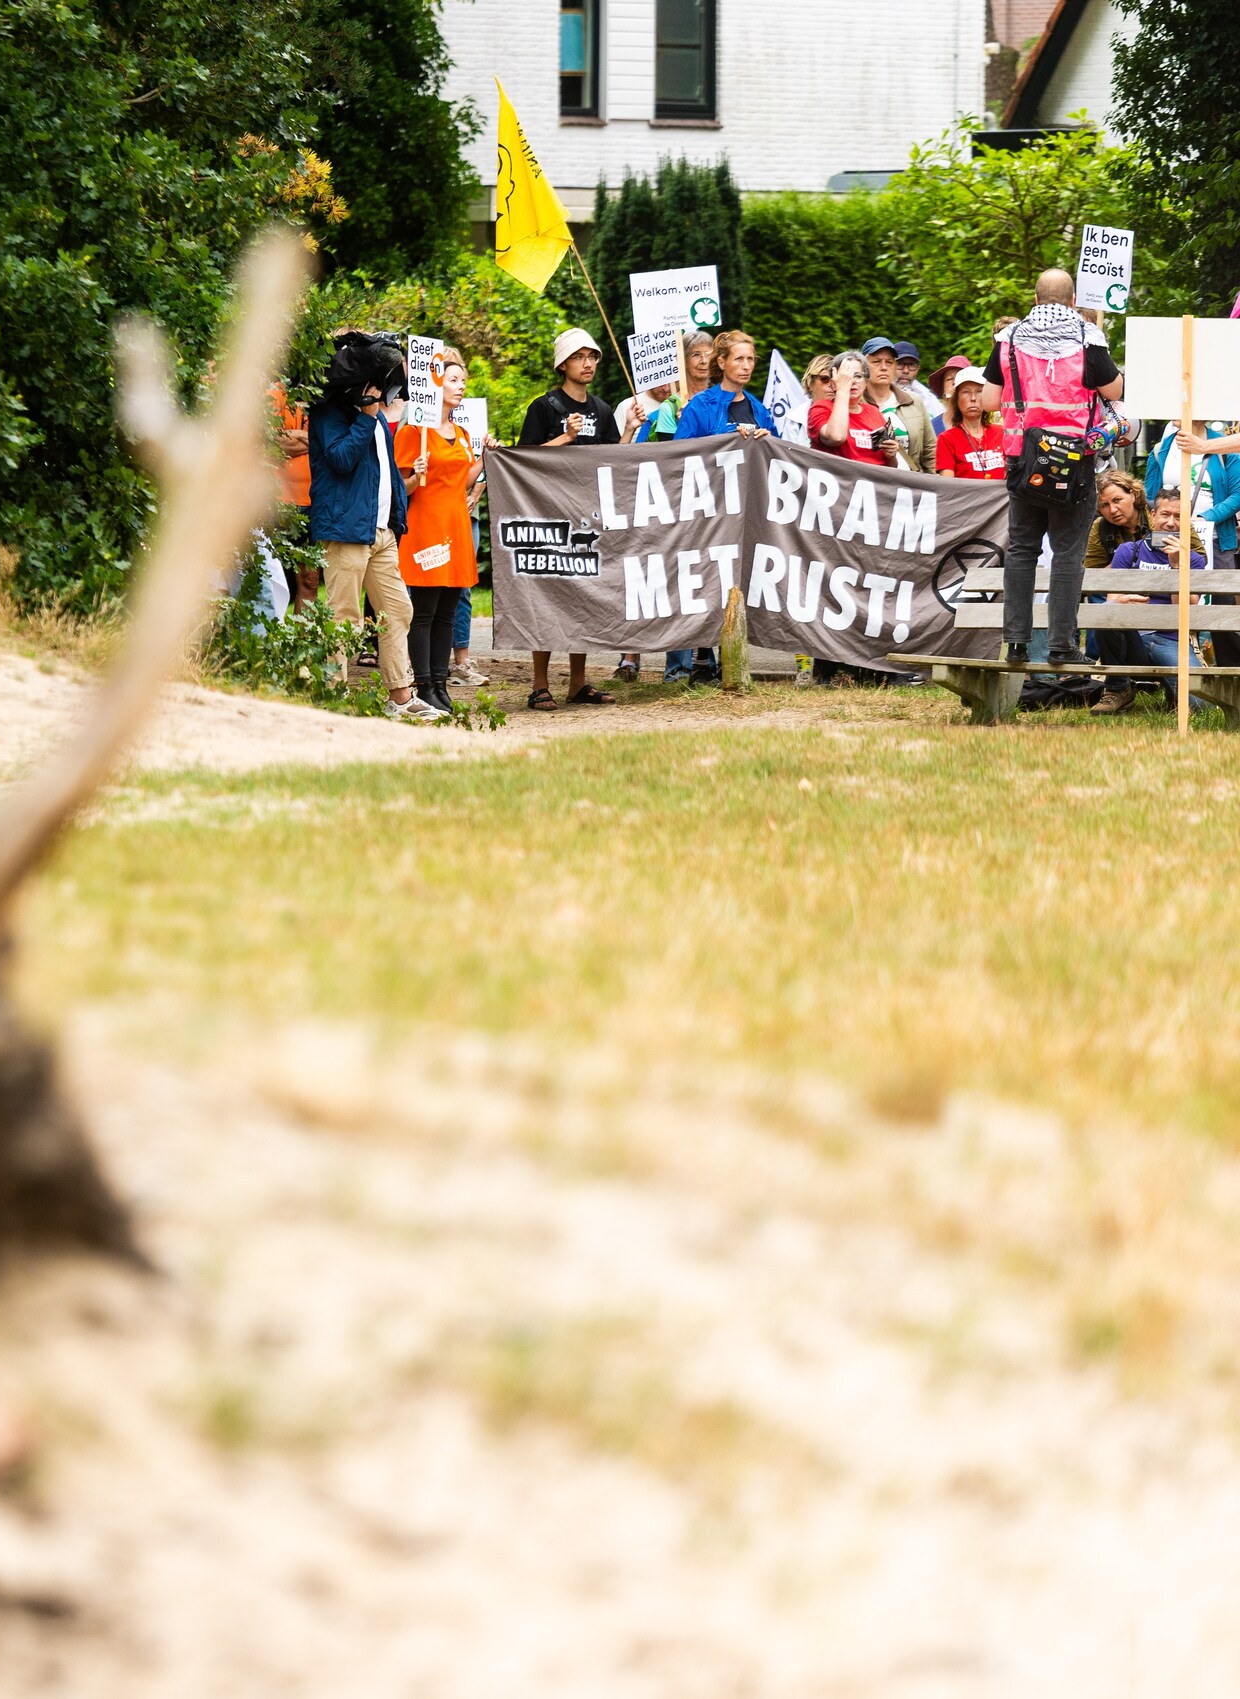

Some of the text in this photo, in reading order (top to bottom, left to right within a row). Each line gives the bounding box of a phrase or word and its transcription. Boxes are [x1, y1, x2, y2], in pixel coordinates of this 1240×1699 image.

[1085, 227, 1128, 247] Ik ben
[1084, 246, 1108, 259] een
[1081, 258, 1124, 278] Ecoïst
[634, 281, 711, 297] Welkom, wolf!
[410, 339, 434, 356] Geef
[630, 333, 650, 347] Tijd
[633, 340, 677, 362] politieke
[410, 356, 441, 373] dieren
[410, 375, 427, 387] een
[637, 365, 679, 385] verande
[410, 391, 436, 405] stem!
[597, 449, 937, 554] LAAT BRAM
[506, 526, 563, 543] ANIMAL
[517, 554, 597, 573] REBELLION
[623, 543, 914, 644] MET RUST!
